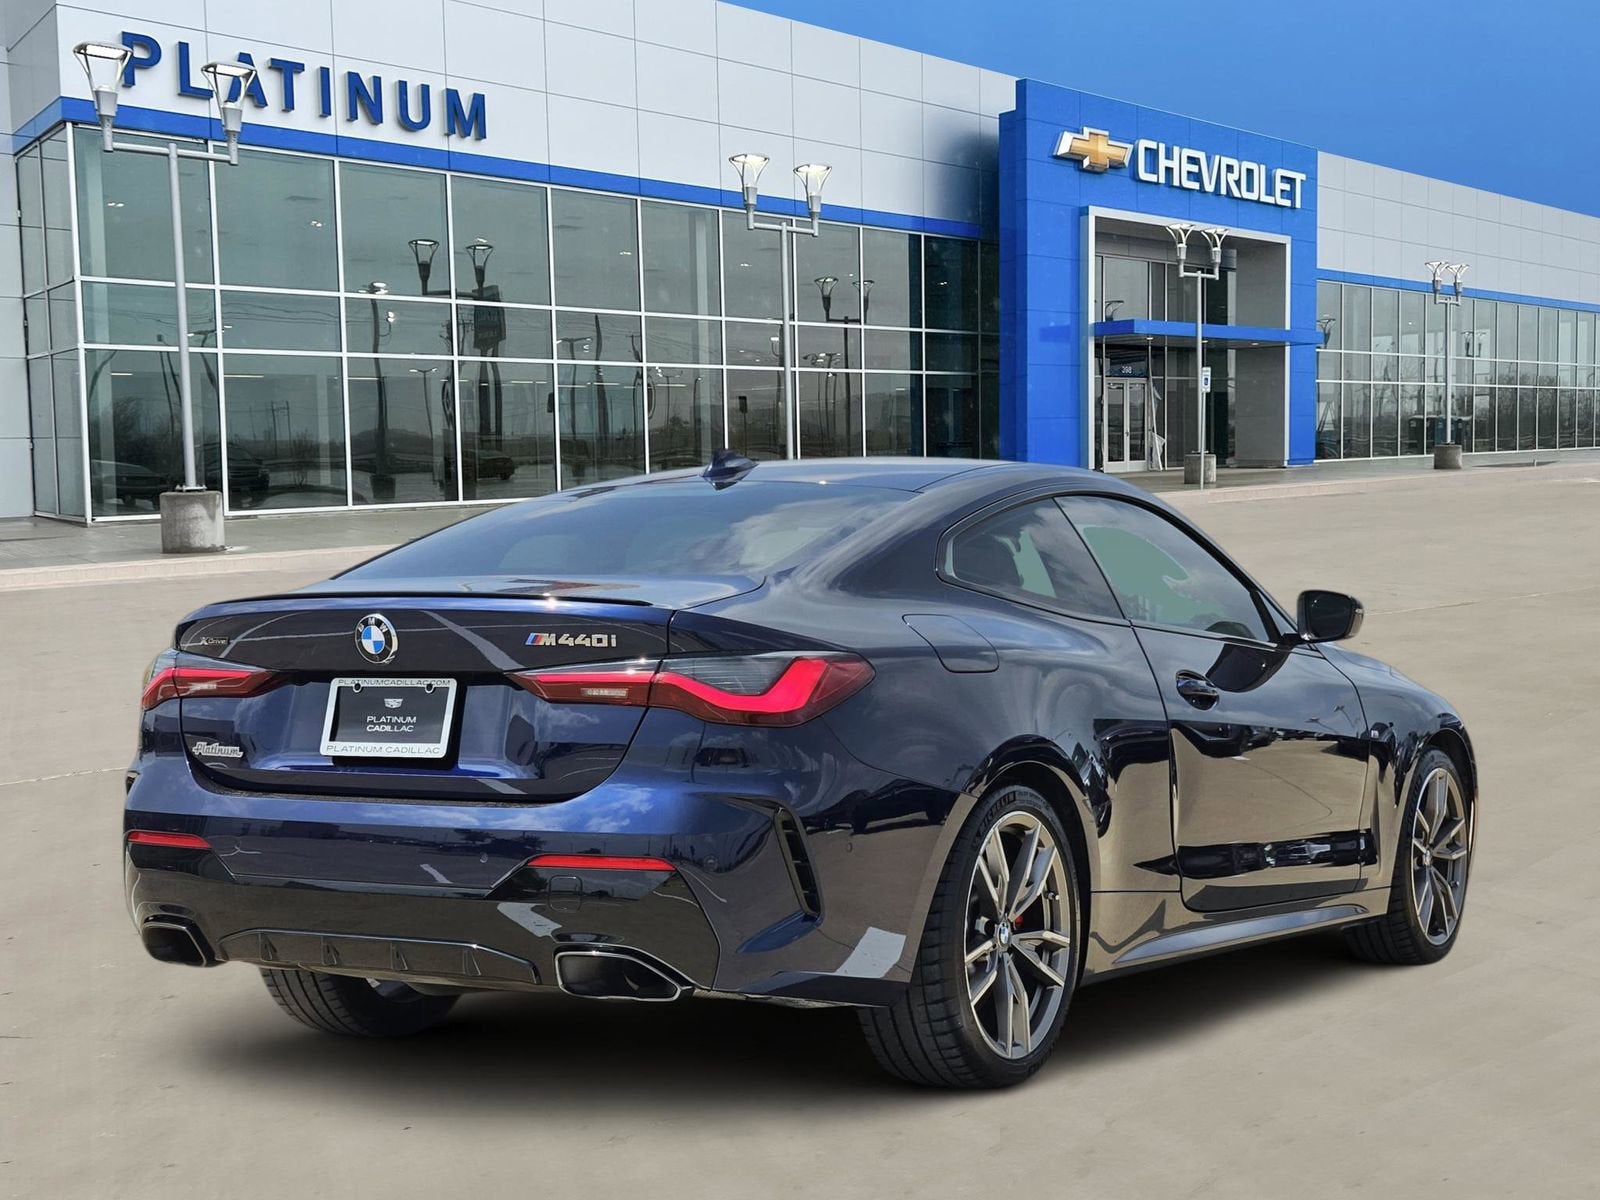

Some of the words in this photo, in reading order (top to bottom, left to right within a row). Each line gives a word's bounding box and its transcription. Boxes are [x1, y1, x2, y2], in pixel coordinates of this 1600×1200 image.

[121, 31, 487, 140] PLATINUM
[1136, 138, 1306, 209] CHEVROLET
[358, 617, 388, 633] BMW
[525, 633, 617, 648] M440i
[366, 715, 417, 724] PLATINUM
[192, 741, 244, 758] Platinum
[326, 745, 382, 753] PLATINUM
[385, 746, 440, 754] CADILLAC
